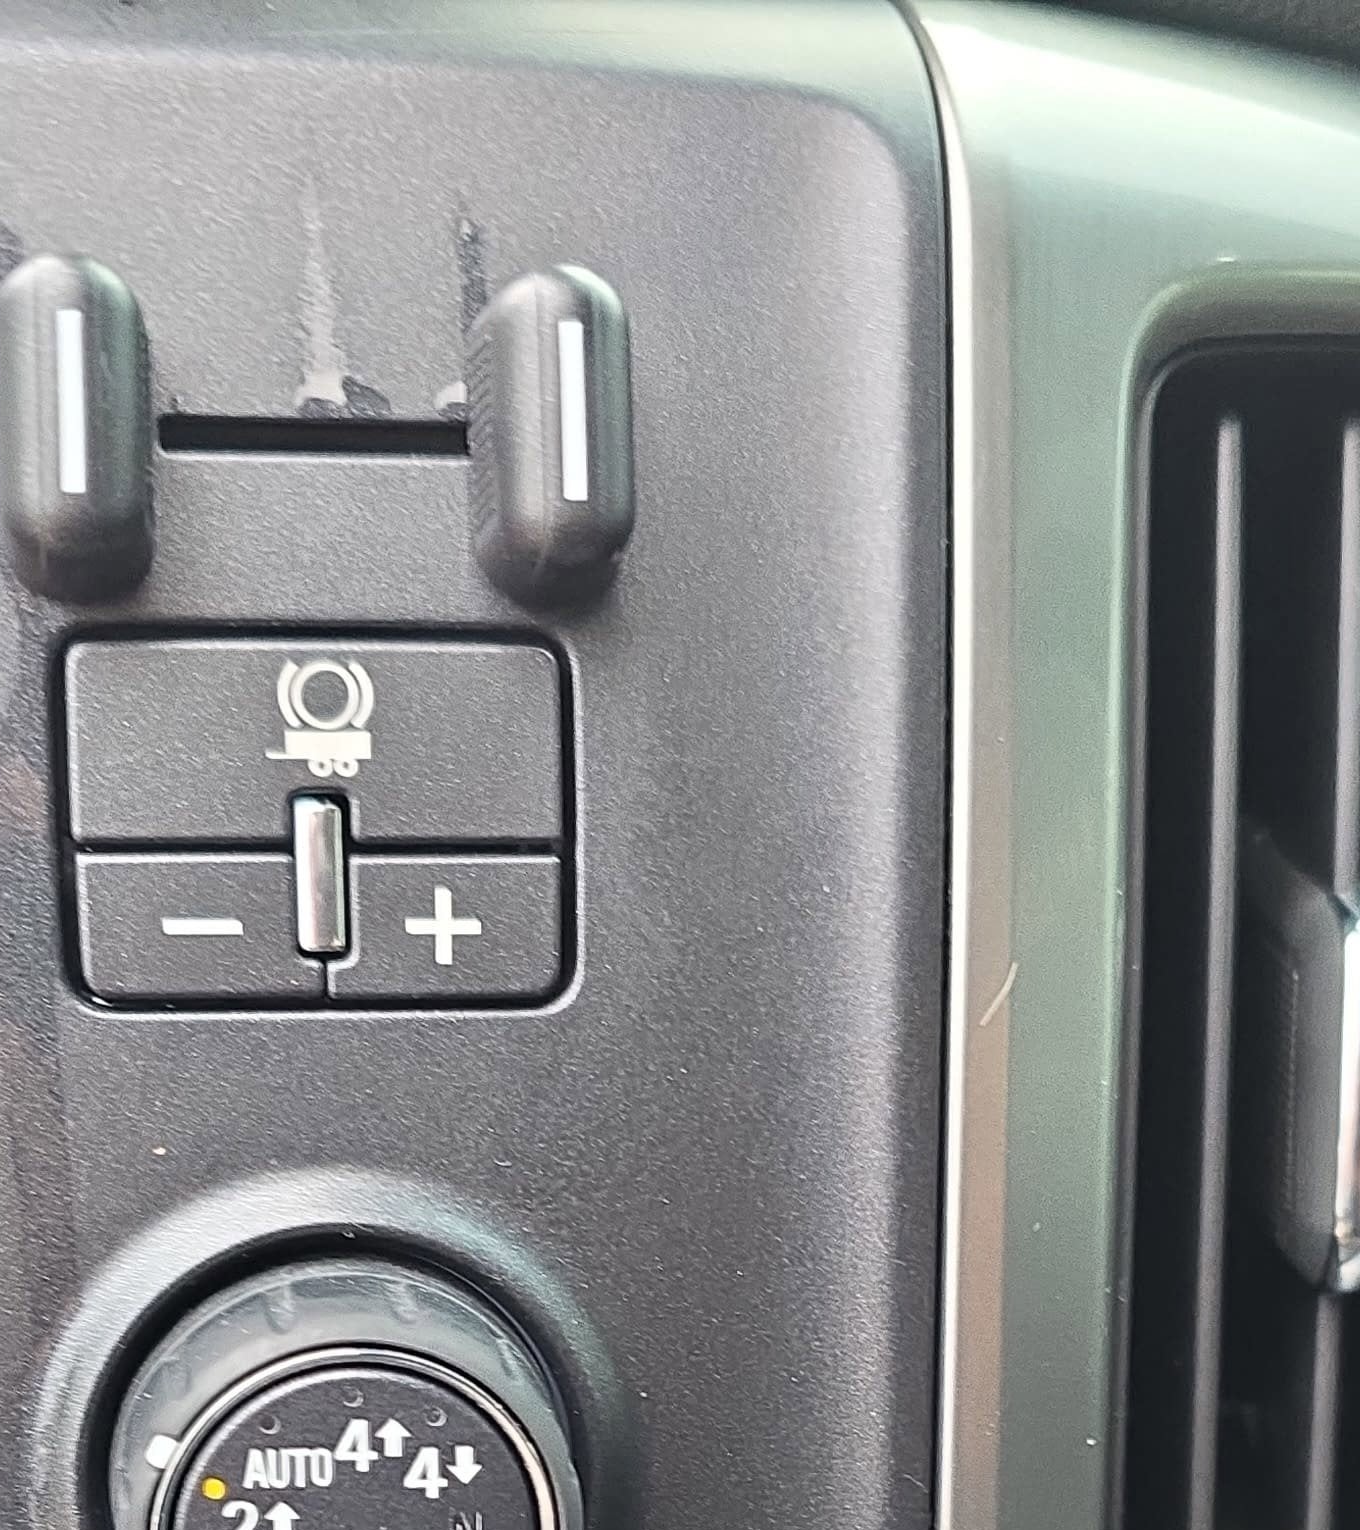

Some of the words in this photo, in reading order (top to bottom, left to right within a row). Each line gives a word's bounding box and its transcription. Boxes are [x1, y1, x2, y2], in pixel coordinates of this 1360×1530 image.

[243, 1447, 333, 1490] AUTO
[334, 1419, 378, 1472] 4
[403, 1447, 447, 1498] 4
